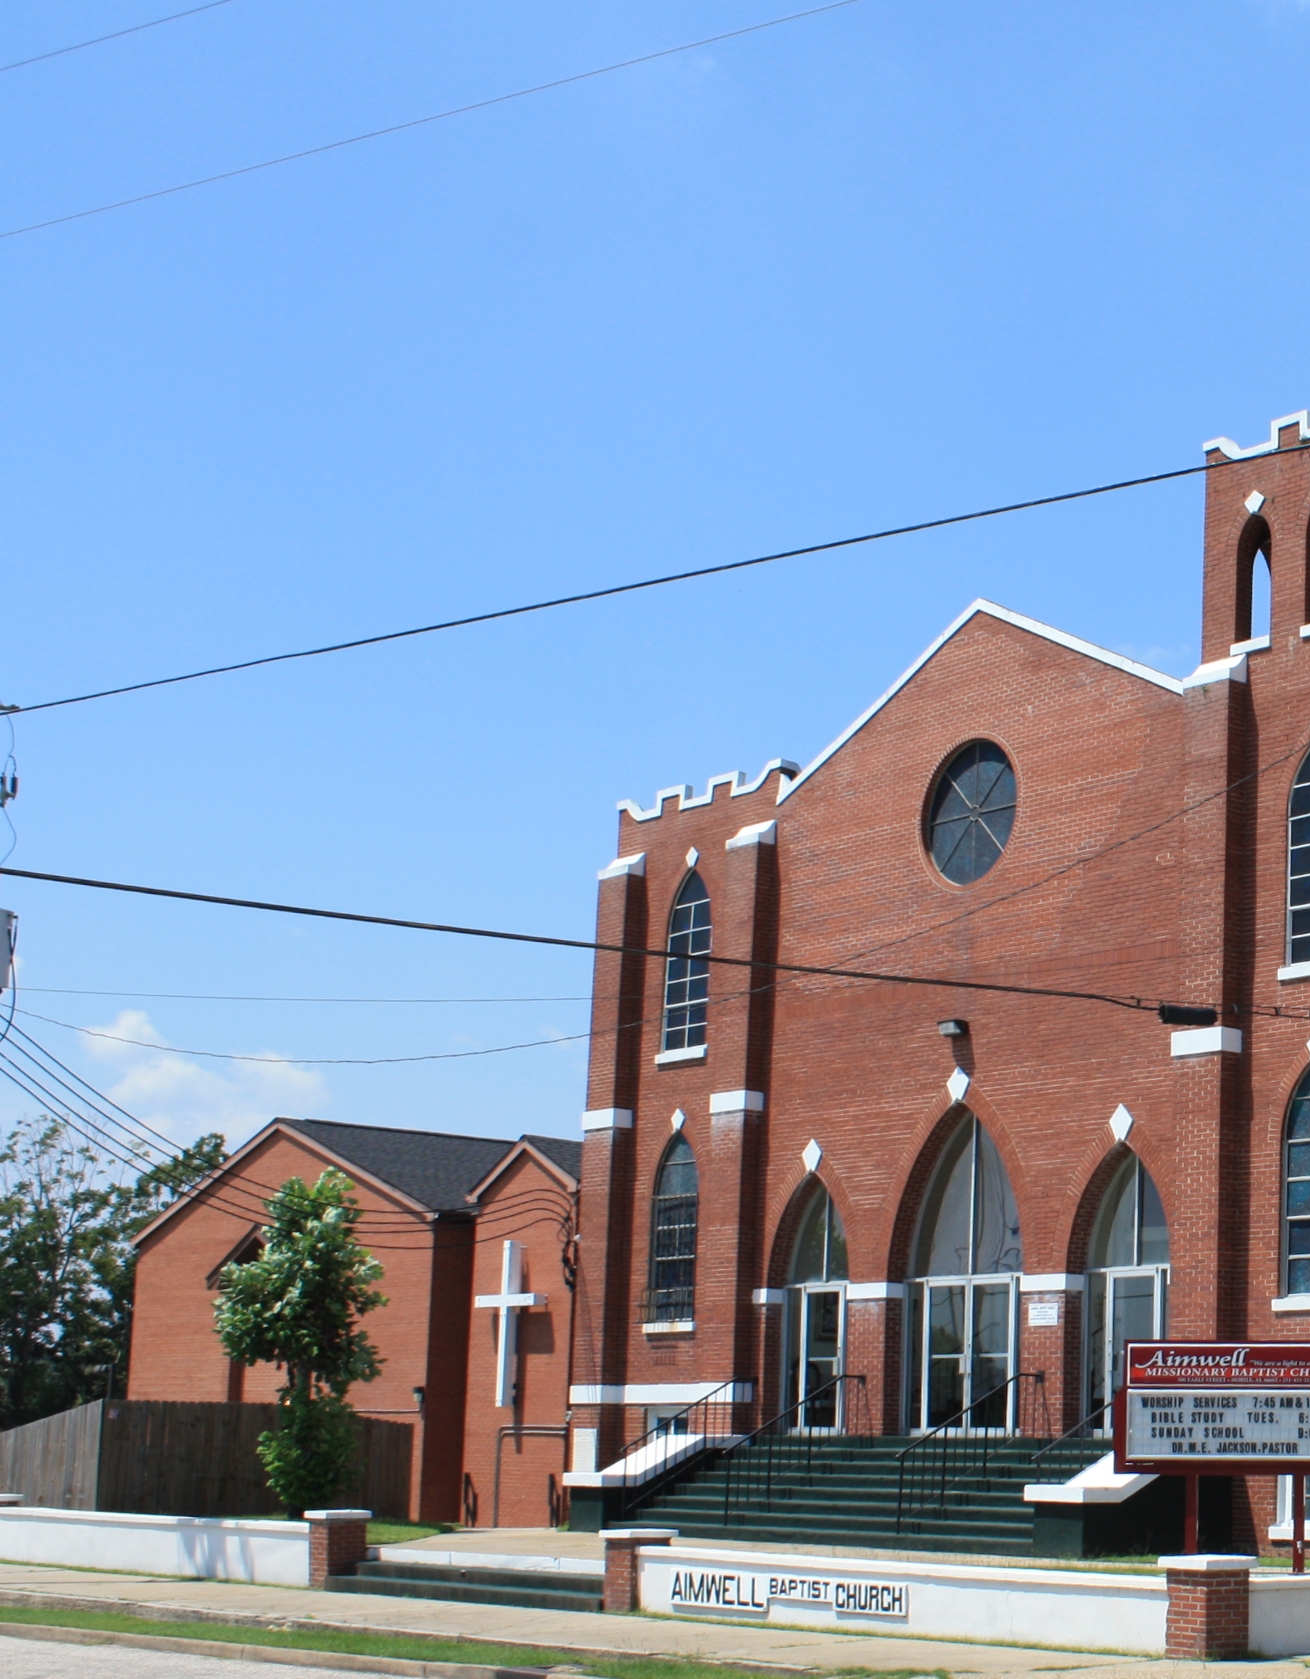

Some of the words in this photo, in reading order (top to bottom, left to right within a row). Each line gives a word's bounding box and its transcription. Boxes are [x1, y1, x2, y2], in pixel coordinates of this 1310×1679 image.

[1134, 1348, 1249, 1368] Aimwell
[1145, 1367, 1226, 1377] MISSIONARY
[1231, 1367, 1287, 1377] BAPTIST
[1141, 1396, 1184, 1408] WORSHIP
[1193, 1396, 1237, 1408] SERVICES
[1253, 1397, 1276, 1408] 7:45
[1151, 1412, 1184, 1423] BIBLE
[1191, 1412, 1224, 1423] STUDY
[1247, 1412, 1279, 1424] TUES.
[1151, 1427, 1194, 1438] SUNDAY
[1204, 1427, 1244, 1438] SCHOOL
[671, 1571, 765, 1608] AIMWELL
[769, 1577, 831, 1600] BAPTIST
[835, 1582, 903, 1612] CHURCH
